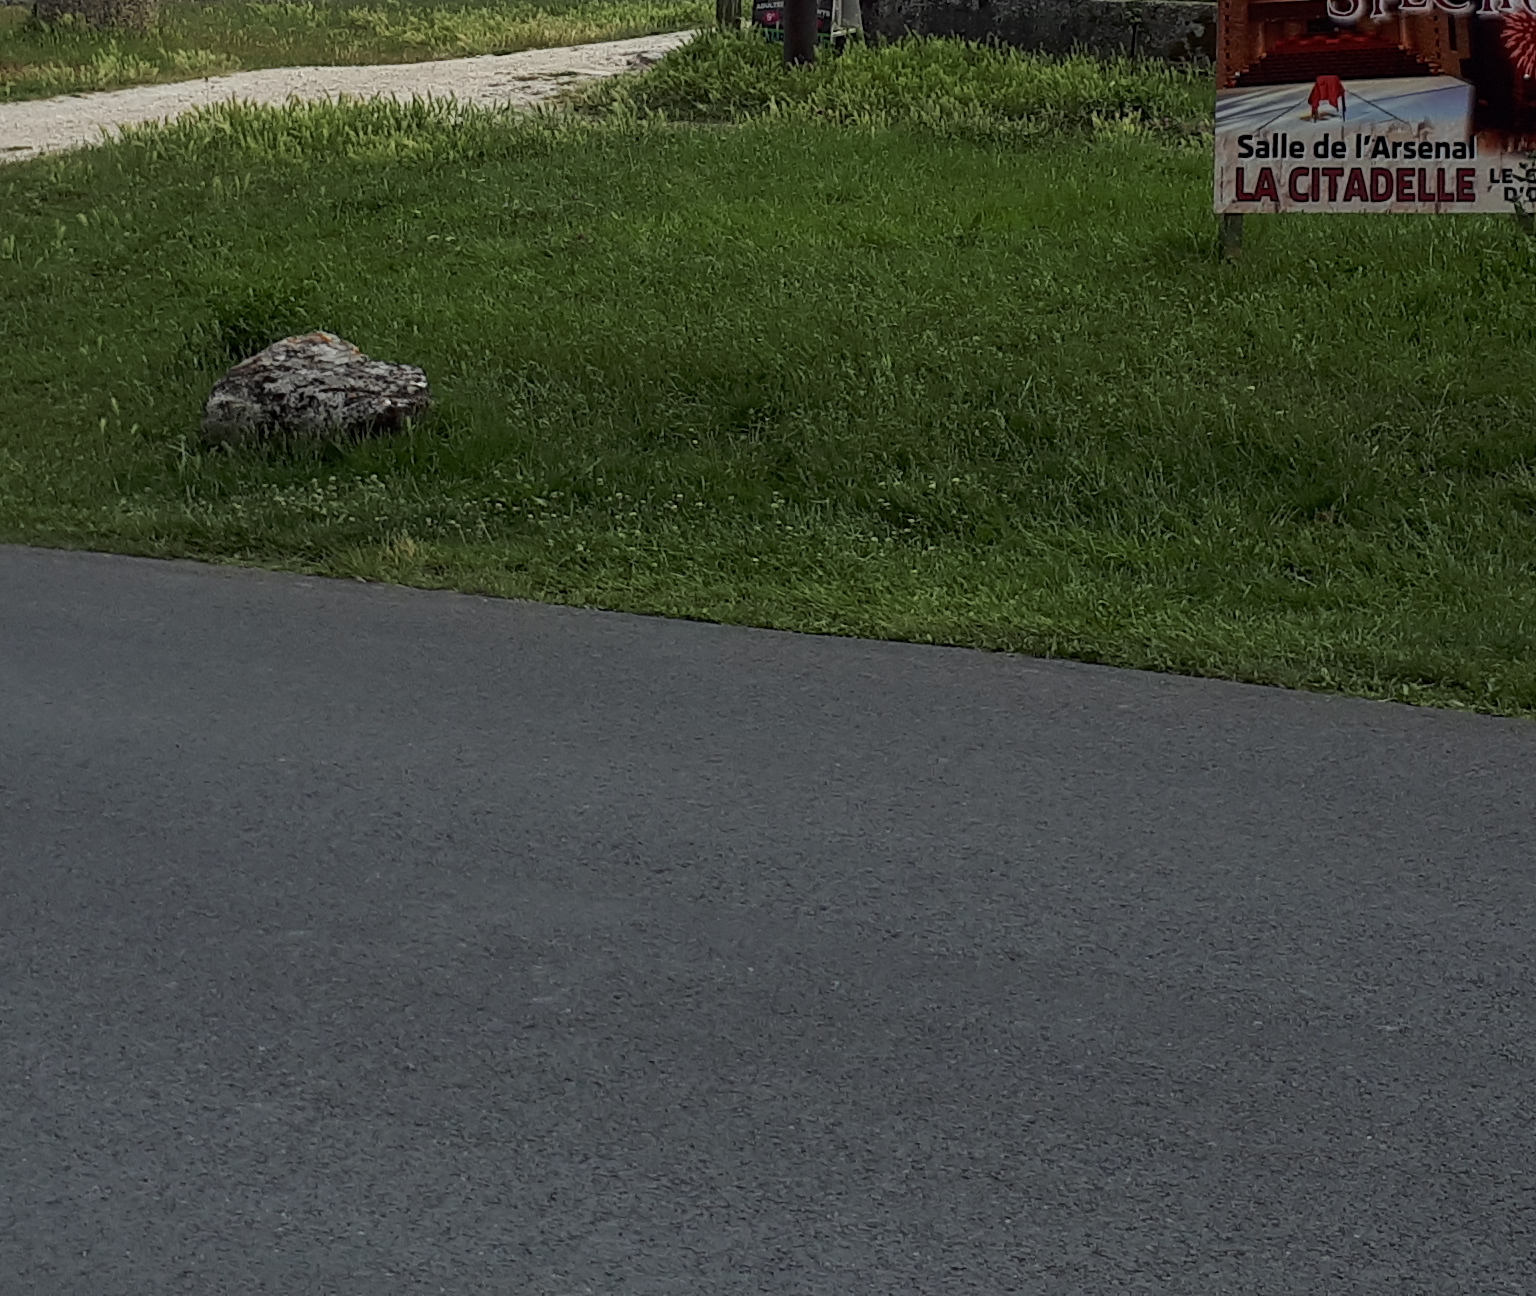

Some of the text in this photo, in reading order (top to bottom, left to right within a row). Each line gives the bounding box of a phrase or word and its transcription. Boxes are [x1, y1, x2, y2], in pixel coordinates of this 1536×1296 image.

[1237, 133, 1476, 159] Salle de l'Arsenal
[1235, 166, 1476, 203] LA CITADELLE
[1489, 168, 1514, 184] LE
